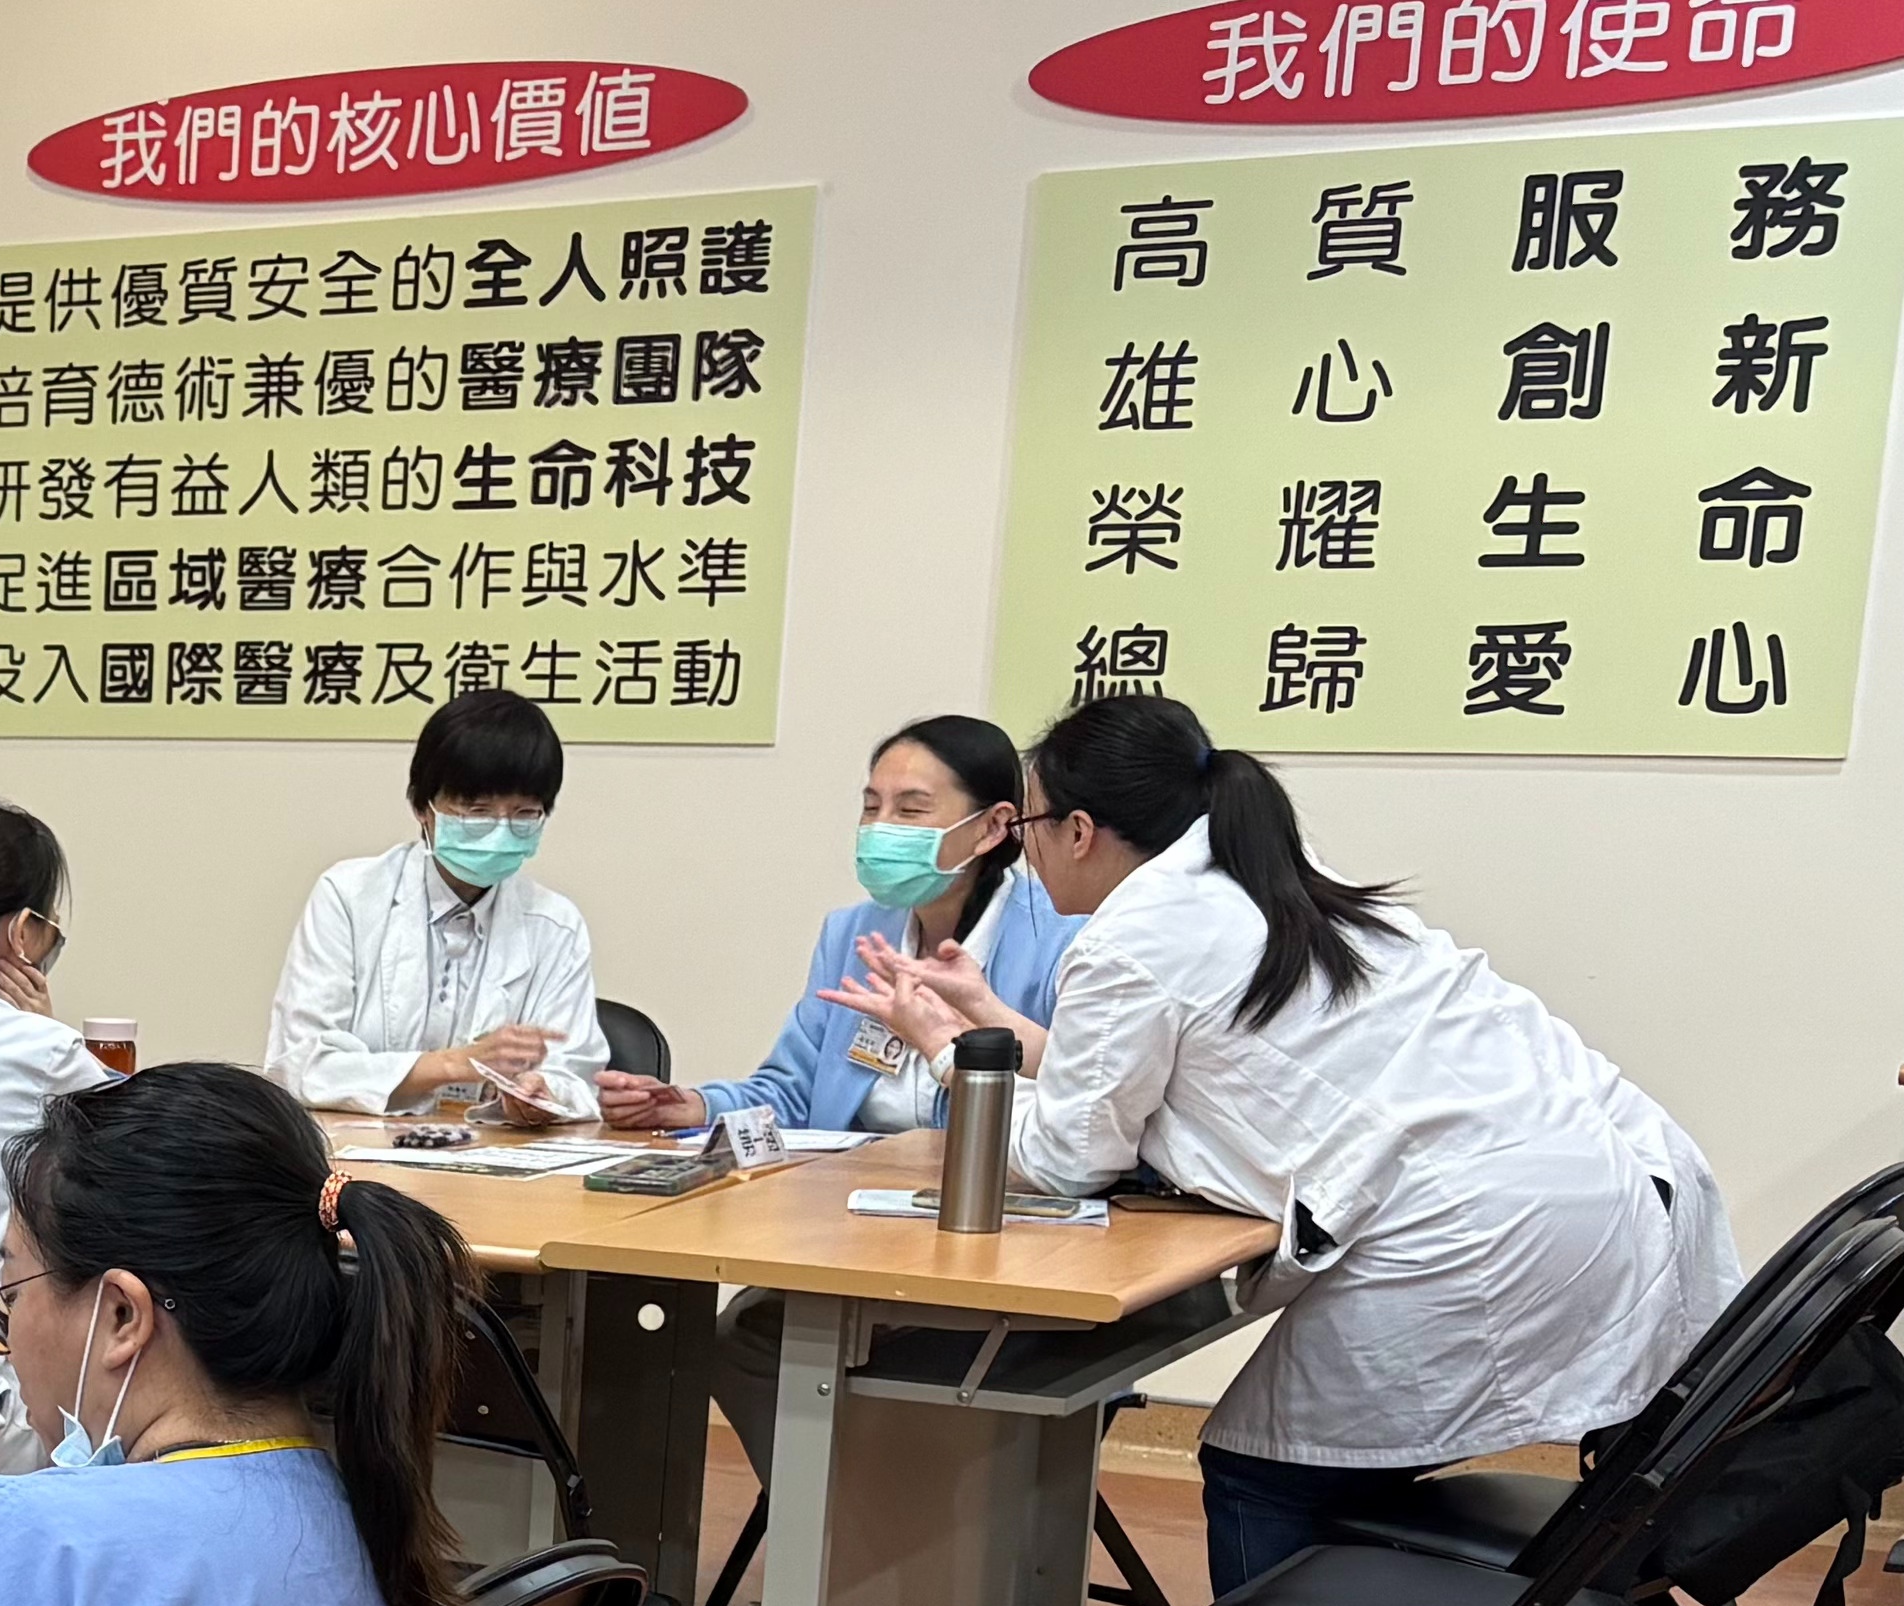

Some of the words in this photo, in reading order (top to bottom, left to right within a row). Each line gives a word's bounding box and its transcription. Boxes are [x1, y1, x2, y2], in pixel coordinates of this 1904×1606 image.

[1203, 0, 1797, 105] 我們的使命
[99, 68, 656, 190] 我們的核心價值
